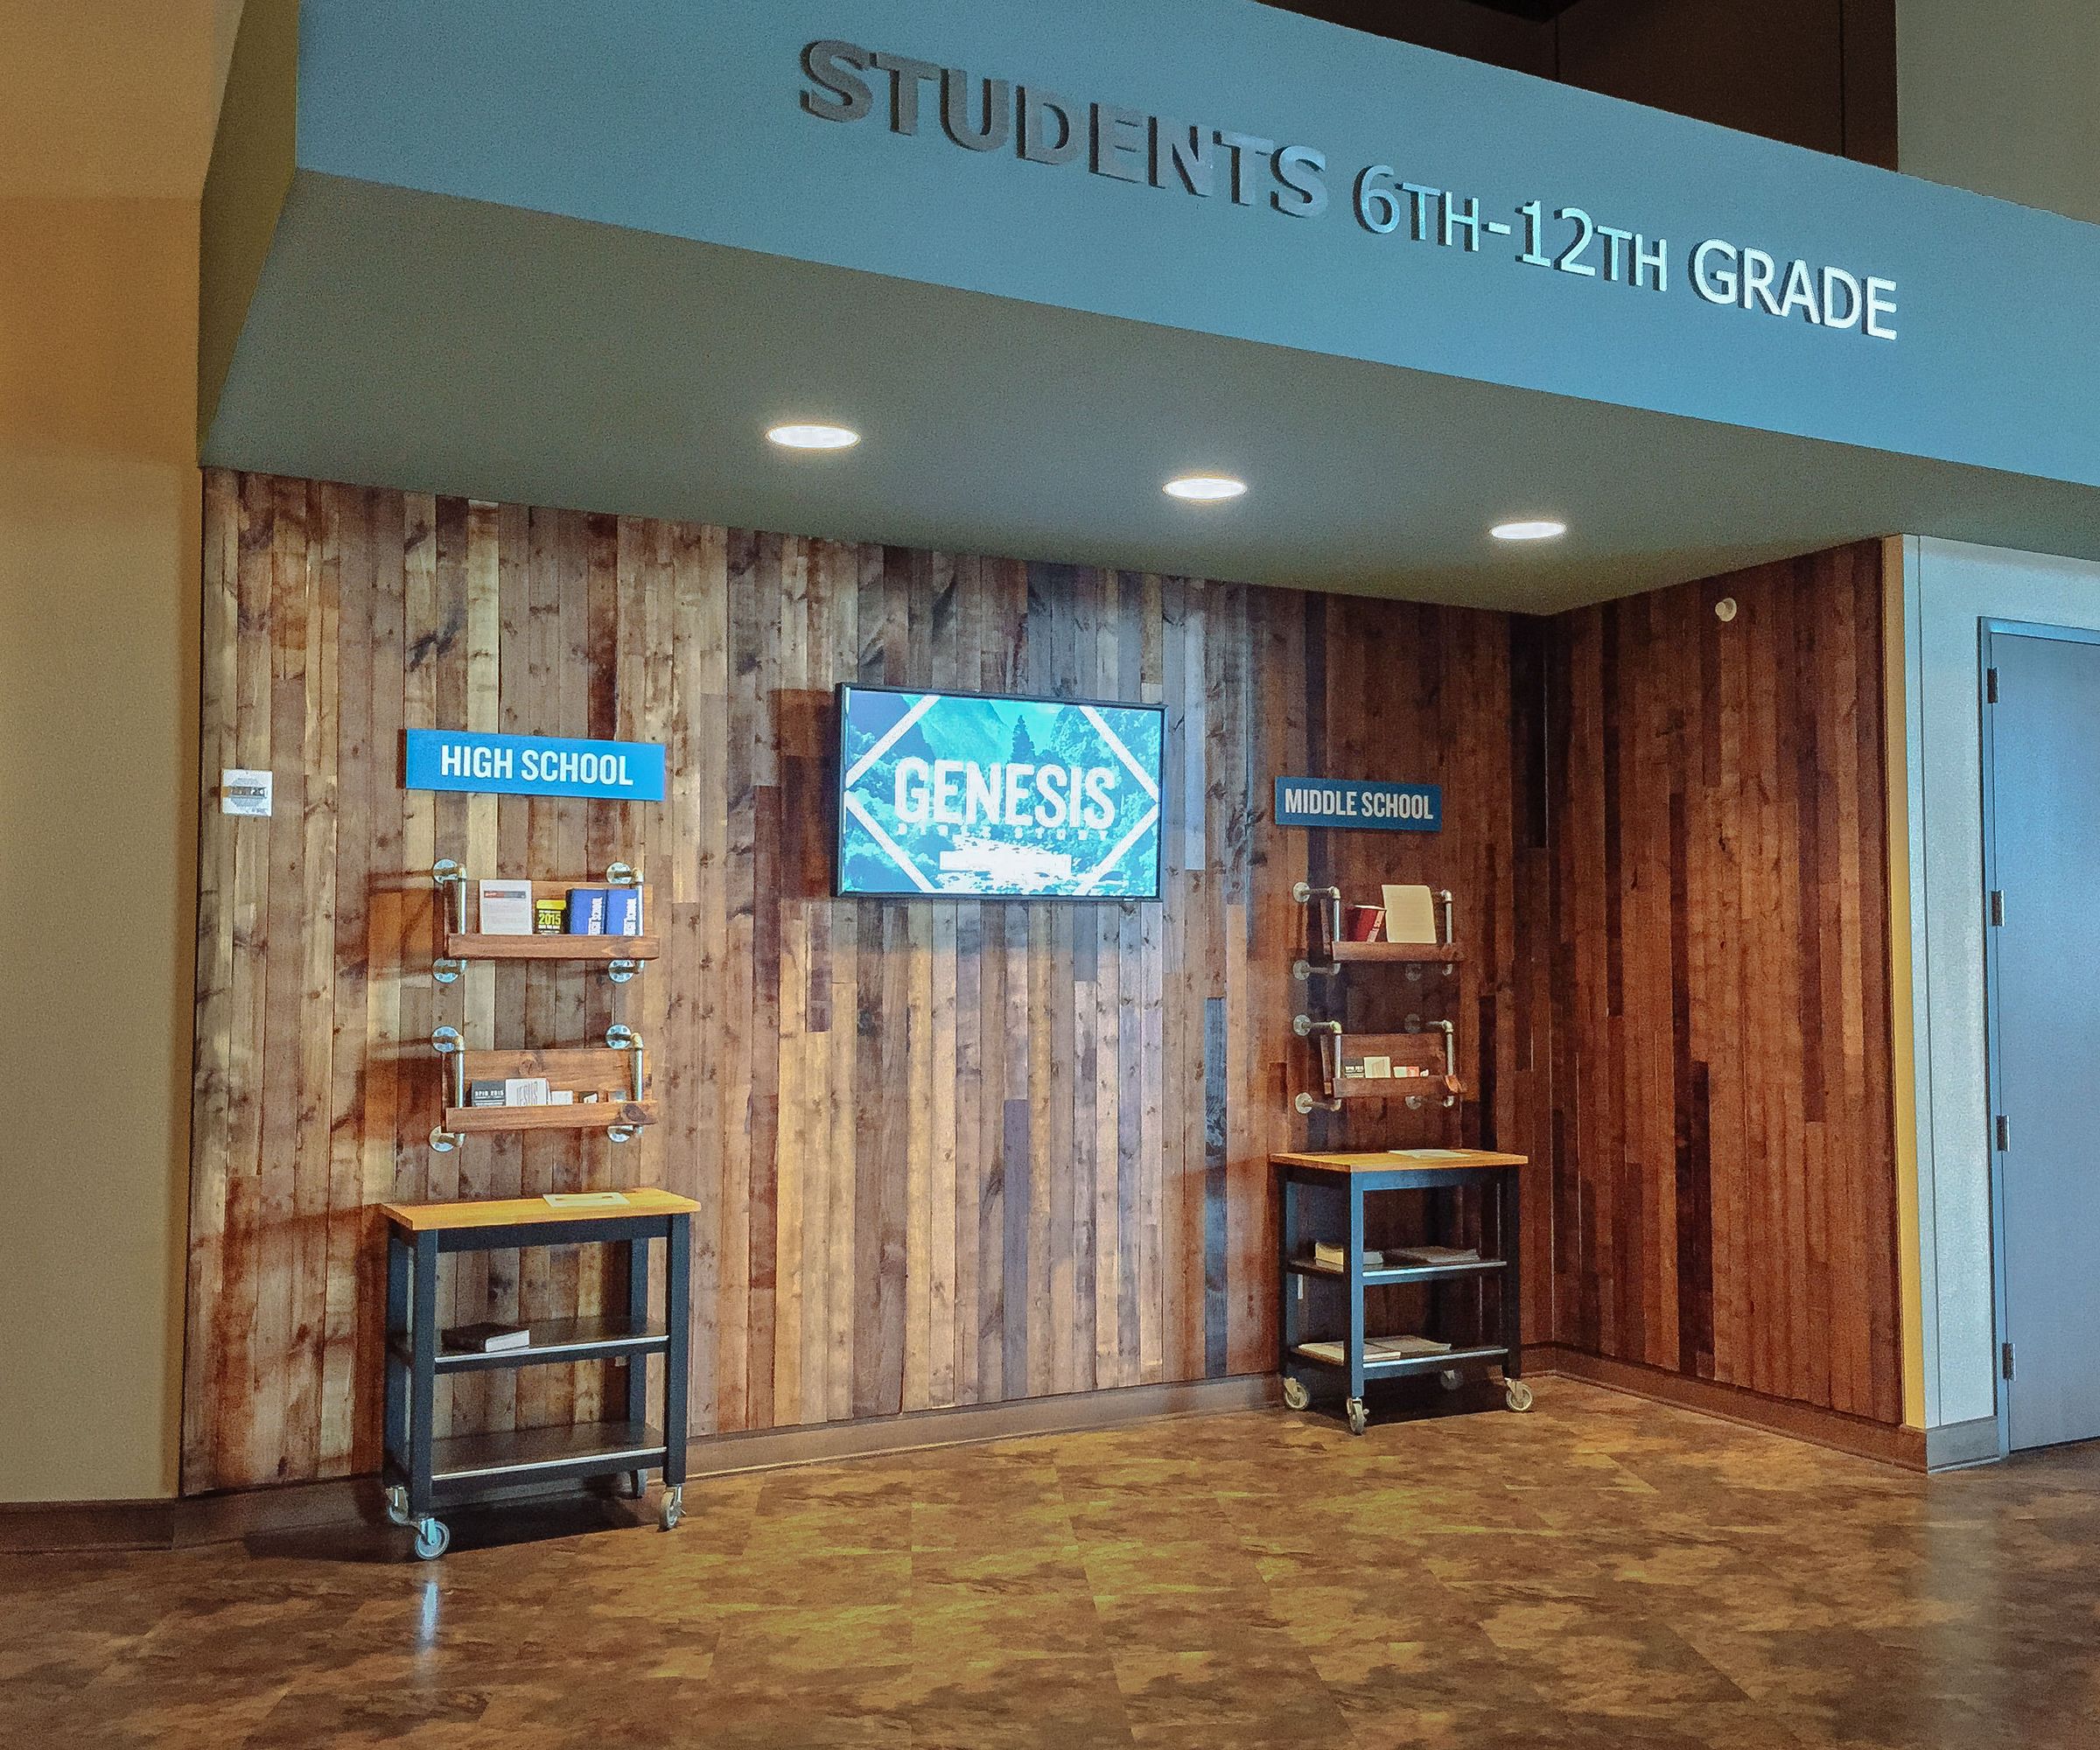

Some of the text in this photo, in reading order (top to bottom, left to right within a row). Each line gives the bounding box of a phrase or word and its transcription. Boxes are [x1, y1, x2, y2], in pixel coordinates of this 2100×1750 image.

[800, 39, 1898, 341] STUDENTS 6TH-12TH GRADE
[441, 745, 634, 786] HIGH SCHOOL
[894, 757, 1116, 830] GENESIS
[1284, 788, 1434, 820] MIDDLE SCHOOL
[538, 913, 561, 925] 2015
